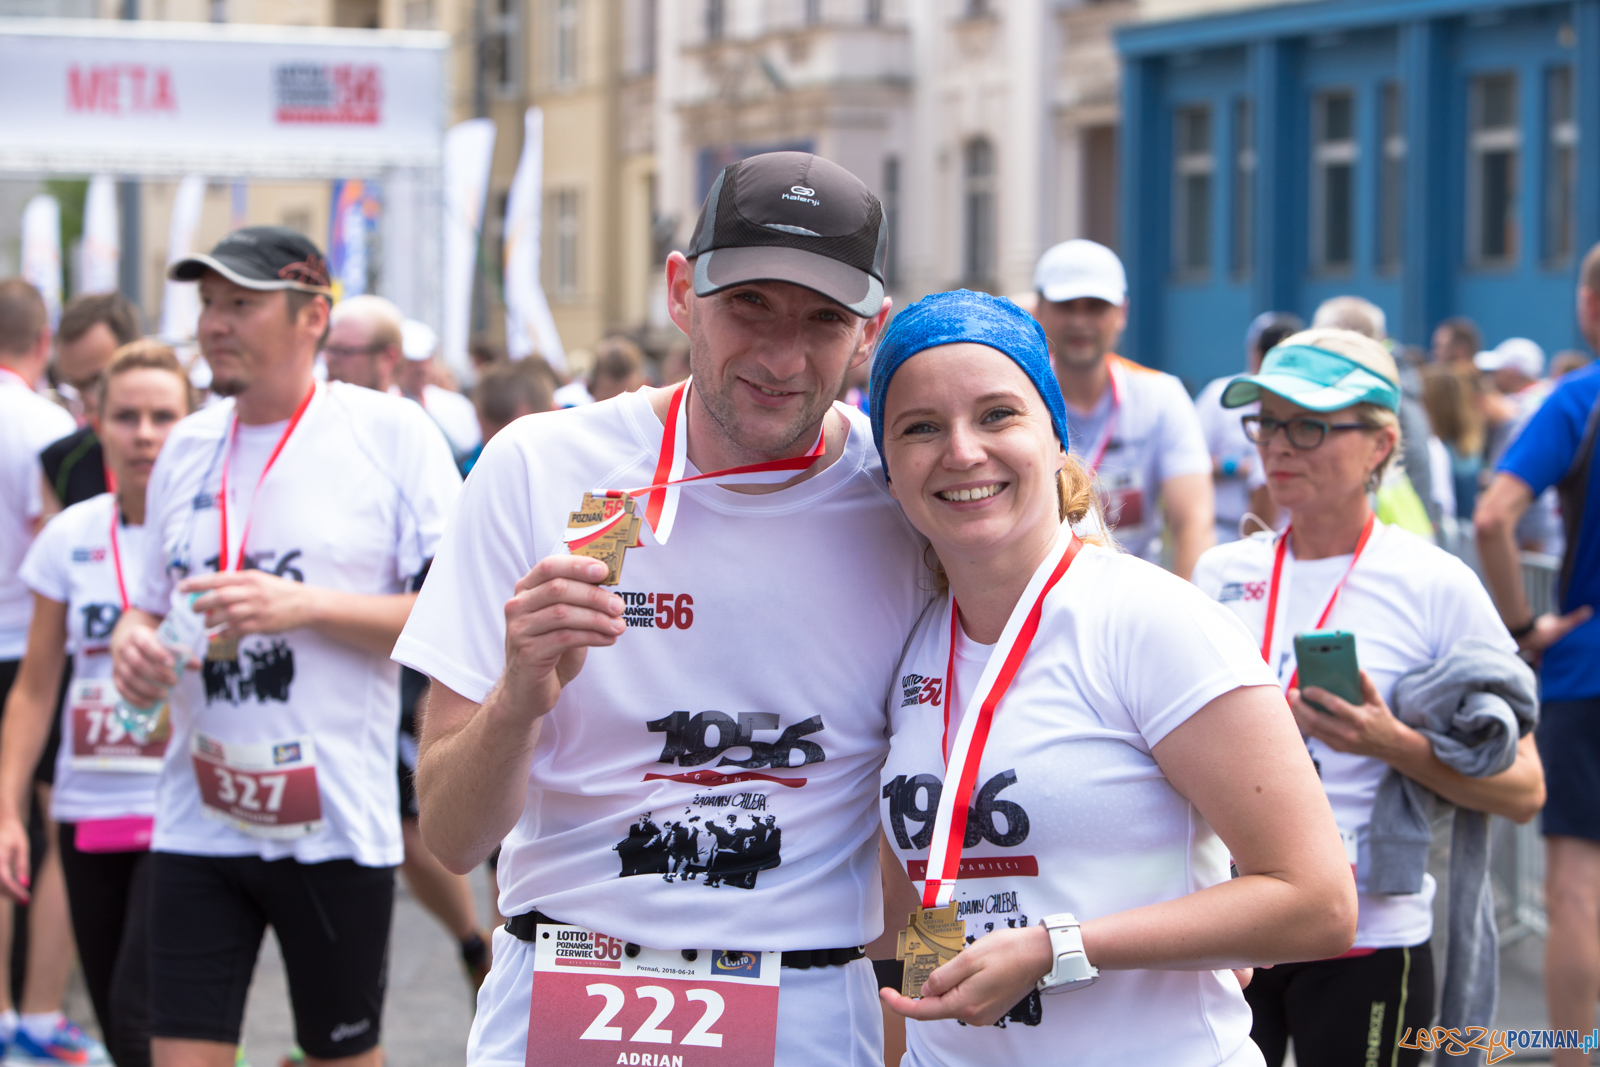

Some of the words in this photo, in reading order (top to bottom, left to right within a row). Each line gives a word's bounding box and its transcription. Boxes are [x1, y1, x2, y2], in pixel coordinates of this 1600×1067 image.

[781, 193, 820, 206] Kalenji
[571, 511, 604, 523] POZNAŃ
[622, 604, 654, 617] NAŃSKI
[647, 592, 694, 630] '56
[646, 710, 826, 769] 1956
[213, 766, 288, 812] 327
[882, 768, 1030, 850] 196
[557, 930, 588, 942] LOTTO
[556, 940, 594, 950] POZNAŃSKI
[555, 948, 593, 958] CZERWIEC
[636, 964, 661, 973] Poznań,
[661, 967, 695, 976] 2018-06-24
[578, 983, 726, 1048] 222
[616, 1052, 684, 1067] ADRIAN
